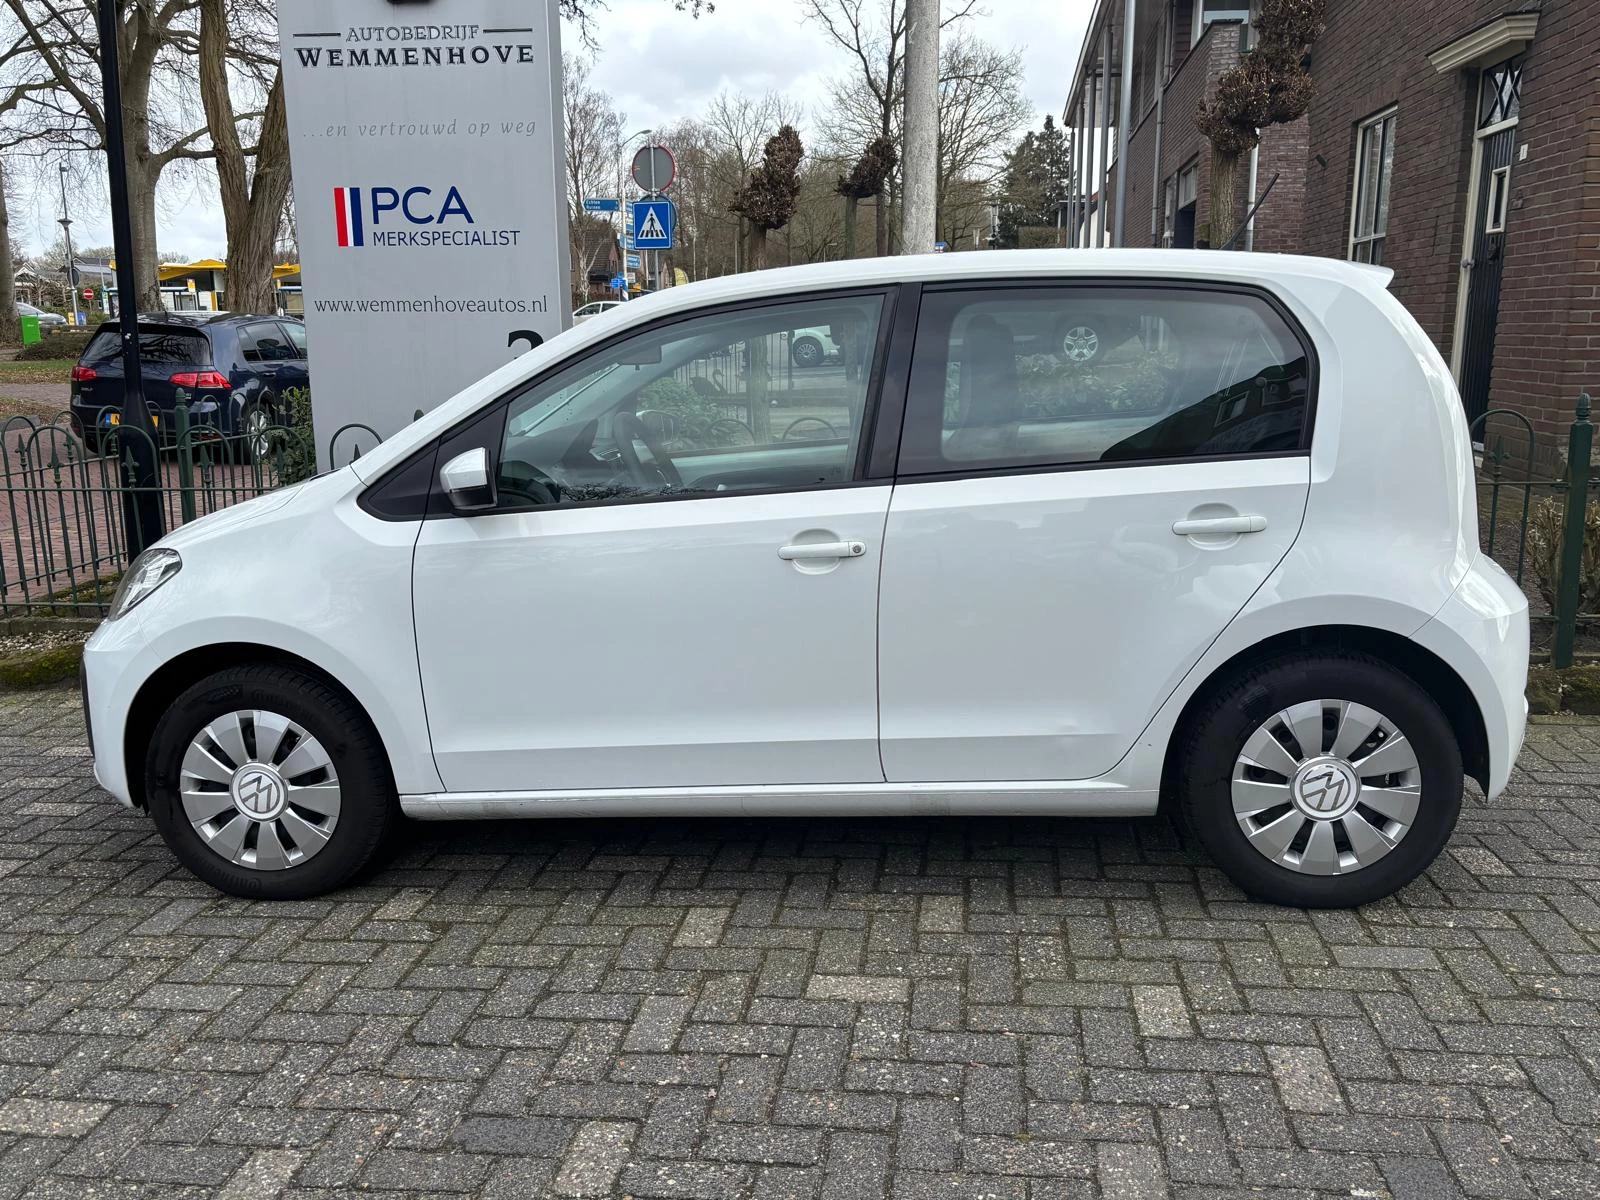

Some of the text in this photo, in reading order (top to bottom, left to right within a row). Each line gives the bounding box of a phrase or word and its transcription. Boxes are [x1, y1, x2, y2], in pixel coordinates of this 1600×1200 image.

[345, 24, 480, 42] AUTOBEDRIJF
[293, 44, 534, 68] WEMMENHOVE
[358, 118, 457, 137] vertrouwd
[468, 121, 491, 138] op
[501, 119, 537, 137] weg
[371, 185, 475, 225] PCA
[373, 230, 521, 247] MERKSPECIALIST
[314, 294, 548, 313] www.wemmenhoveautos.nl
